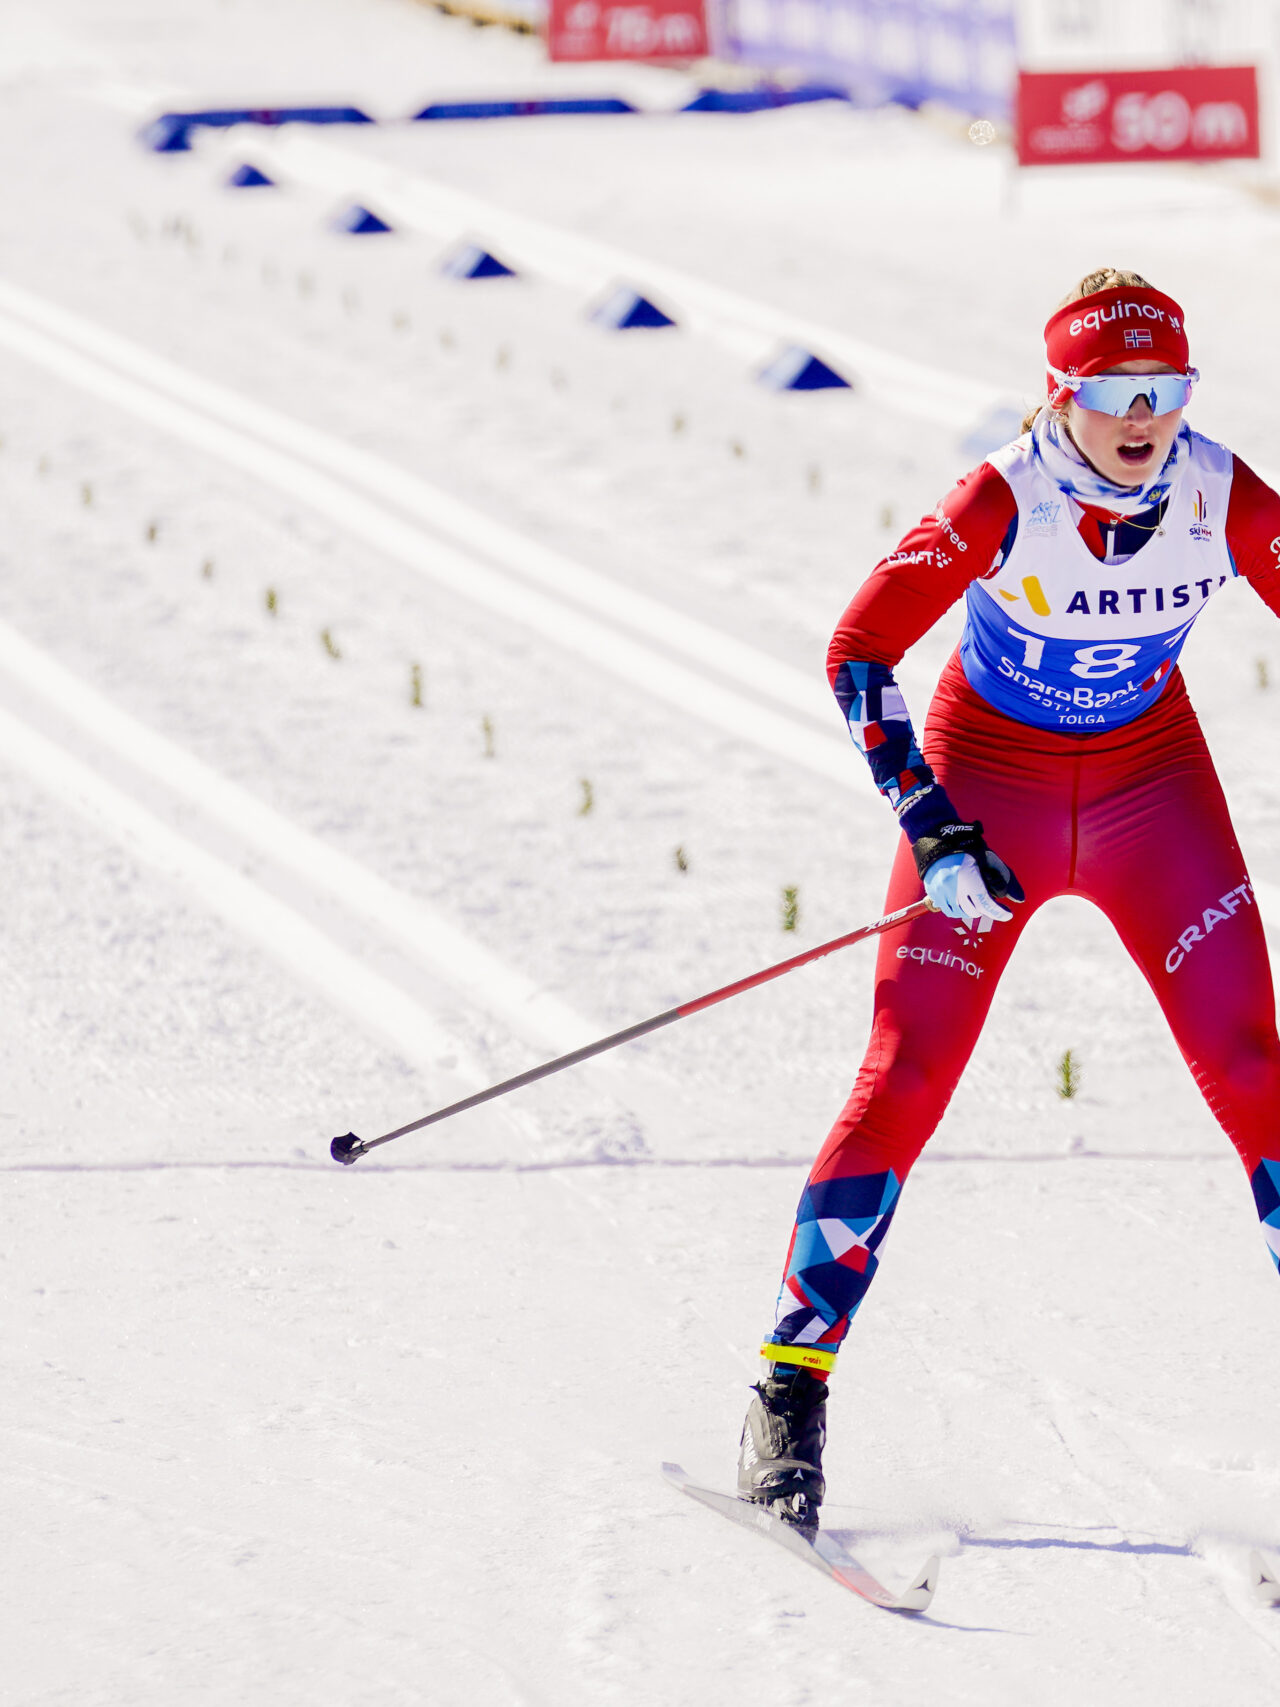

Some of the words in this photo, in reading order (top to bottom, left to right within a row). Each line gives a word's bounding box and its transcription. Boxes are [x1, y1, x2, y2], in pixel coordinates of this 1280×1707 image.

[1111, 91, 1191, 152] 50
[1191, 101, 1248, 150] m
[1069, 300, 1165, 336] equinor
[887, 551, 934, 566] CRAFT
[1058, 714, 1106, 725] TOLGA
[1165, 883, 1252, 974] CRAFT
[896, 945, 985, 980] equinor
